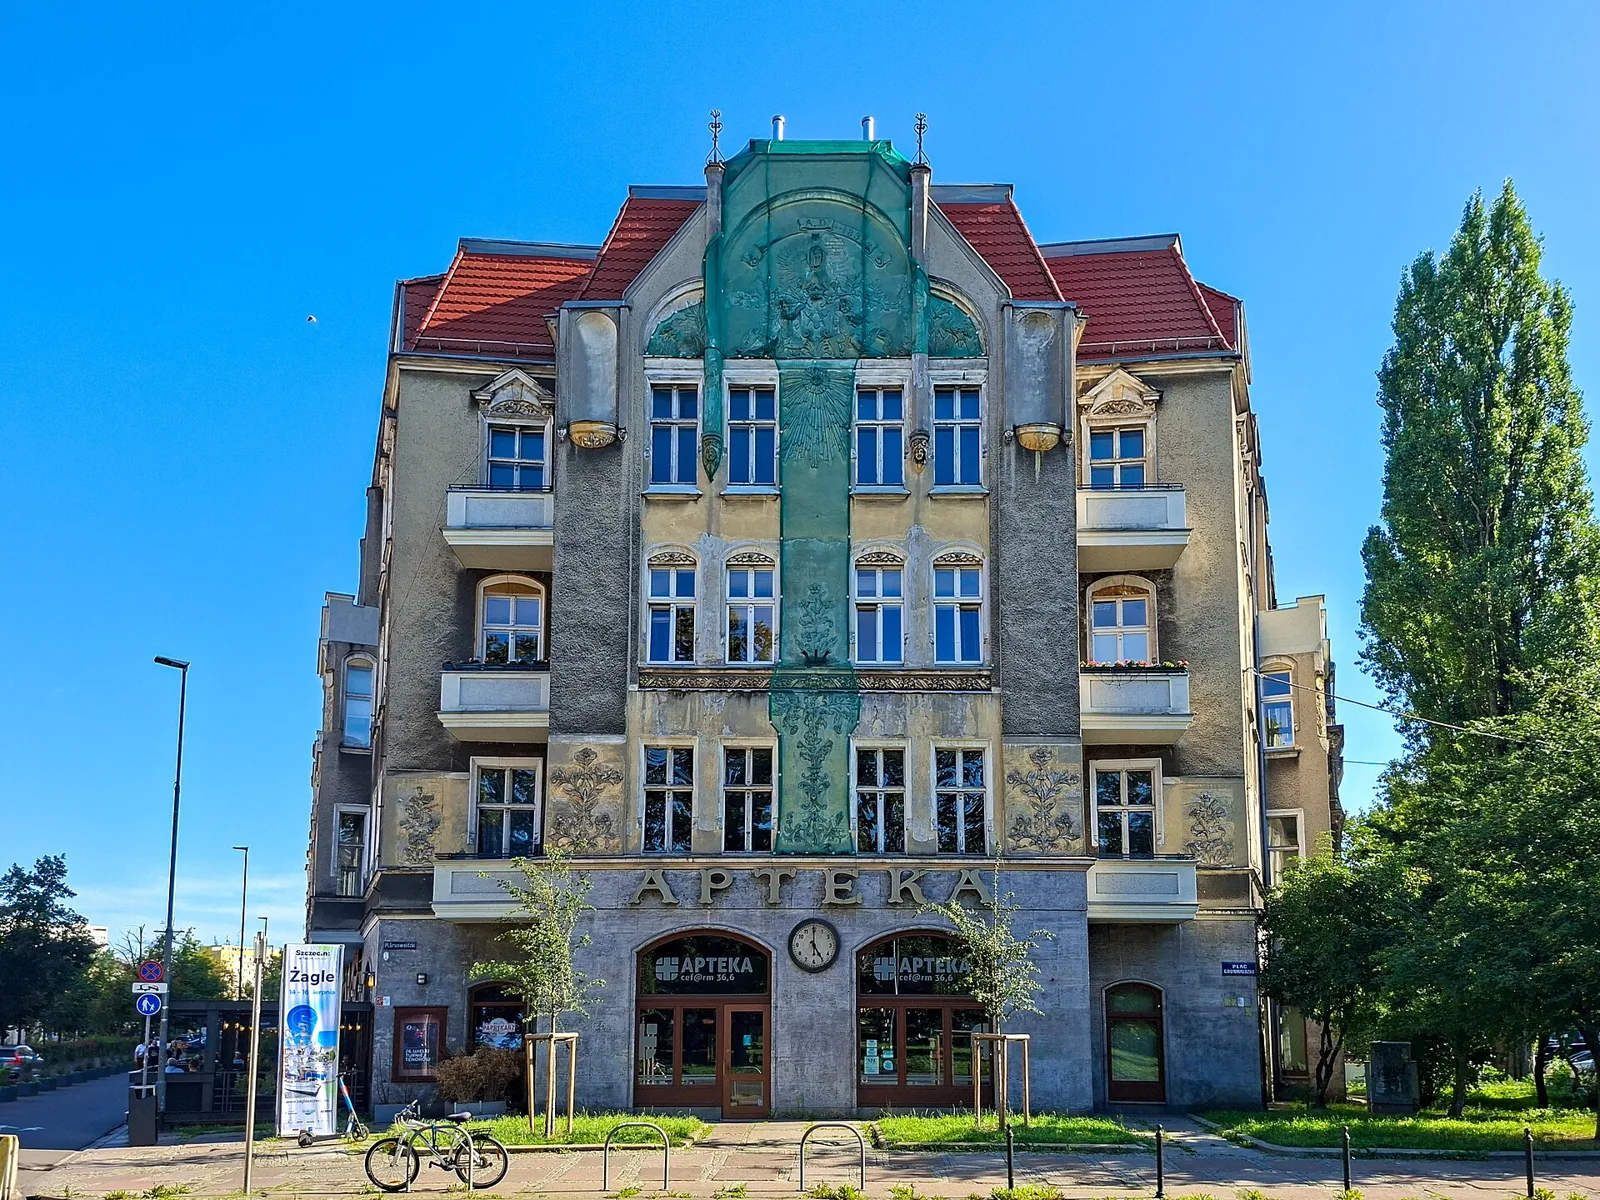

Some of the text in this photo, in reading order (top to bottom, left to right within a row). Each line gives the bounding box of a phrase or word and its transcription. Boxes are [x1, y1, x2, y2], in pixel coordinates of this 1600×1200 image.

[628, 868, 994, 905] APTEKA
[680, 957, 753, 973] APTEKA
[900, 957, 971, 974] APTEKA
[289, 966, 335, 986] Żagle
[680, 974, 735, 982] cef@rm 36,6
[899, 974, 954, 982] cef@rm 36,6
